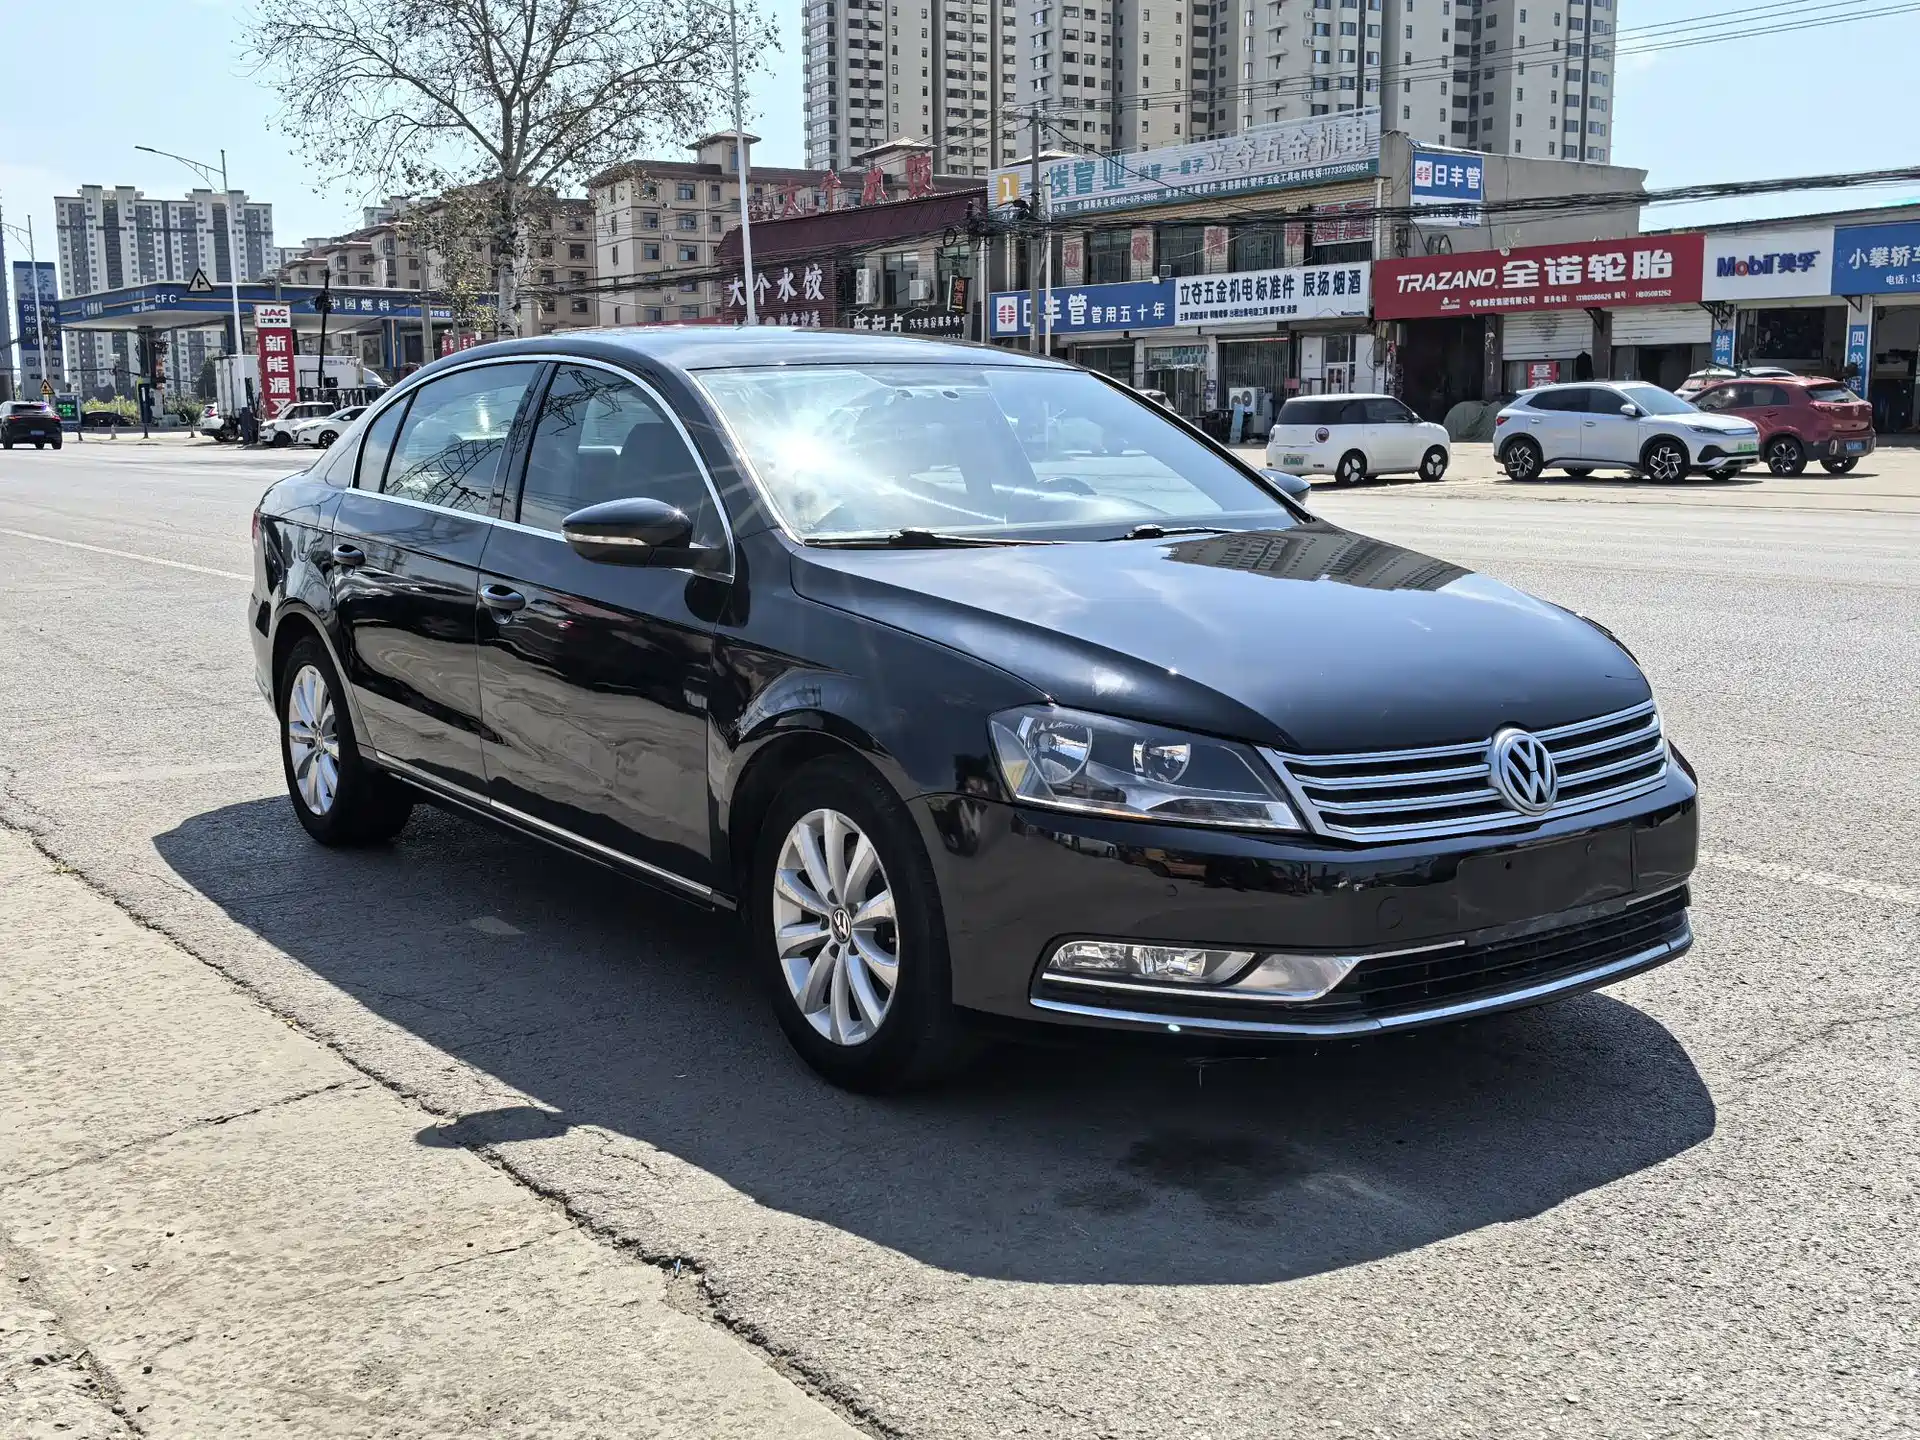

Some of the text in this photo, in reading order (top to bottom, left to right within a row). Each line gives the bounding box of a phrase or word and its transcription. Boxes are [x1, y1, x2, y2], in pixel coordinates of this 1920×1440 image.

[1435, 164, 1481, 190] 日丰管
[1396, 249, 1673, 294] TRAZANO 全诺轮胎
[1777, 250, 1821, 273] 美孚
[728, 263, 825, 307] 大个水饺
[1179, 269, 1362, 306] 立夺五金机电标准件 辰扬烟酒
[154, 294, 177, 304] CFC
[330, 297, 391, 312] 中国燃料
[1023, 293, 1165, 327] 日丰管 管用五十年
[260, 308, 288, 317] JAC
